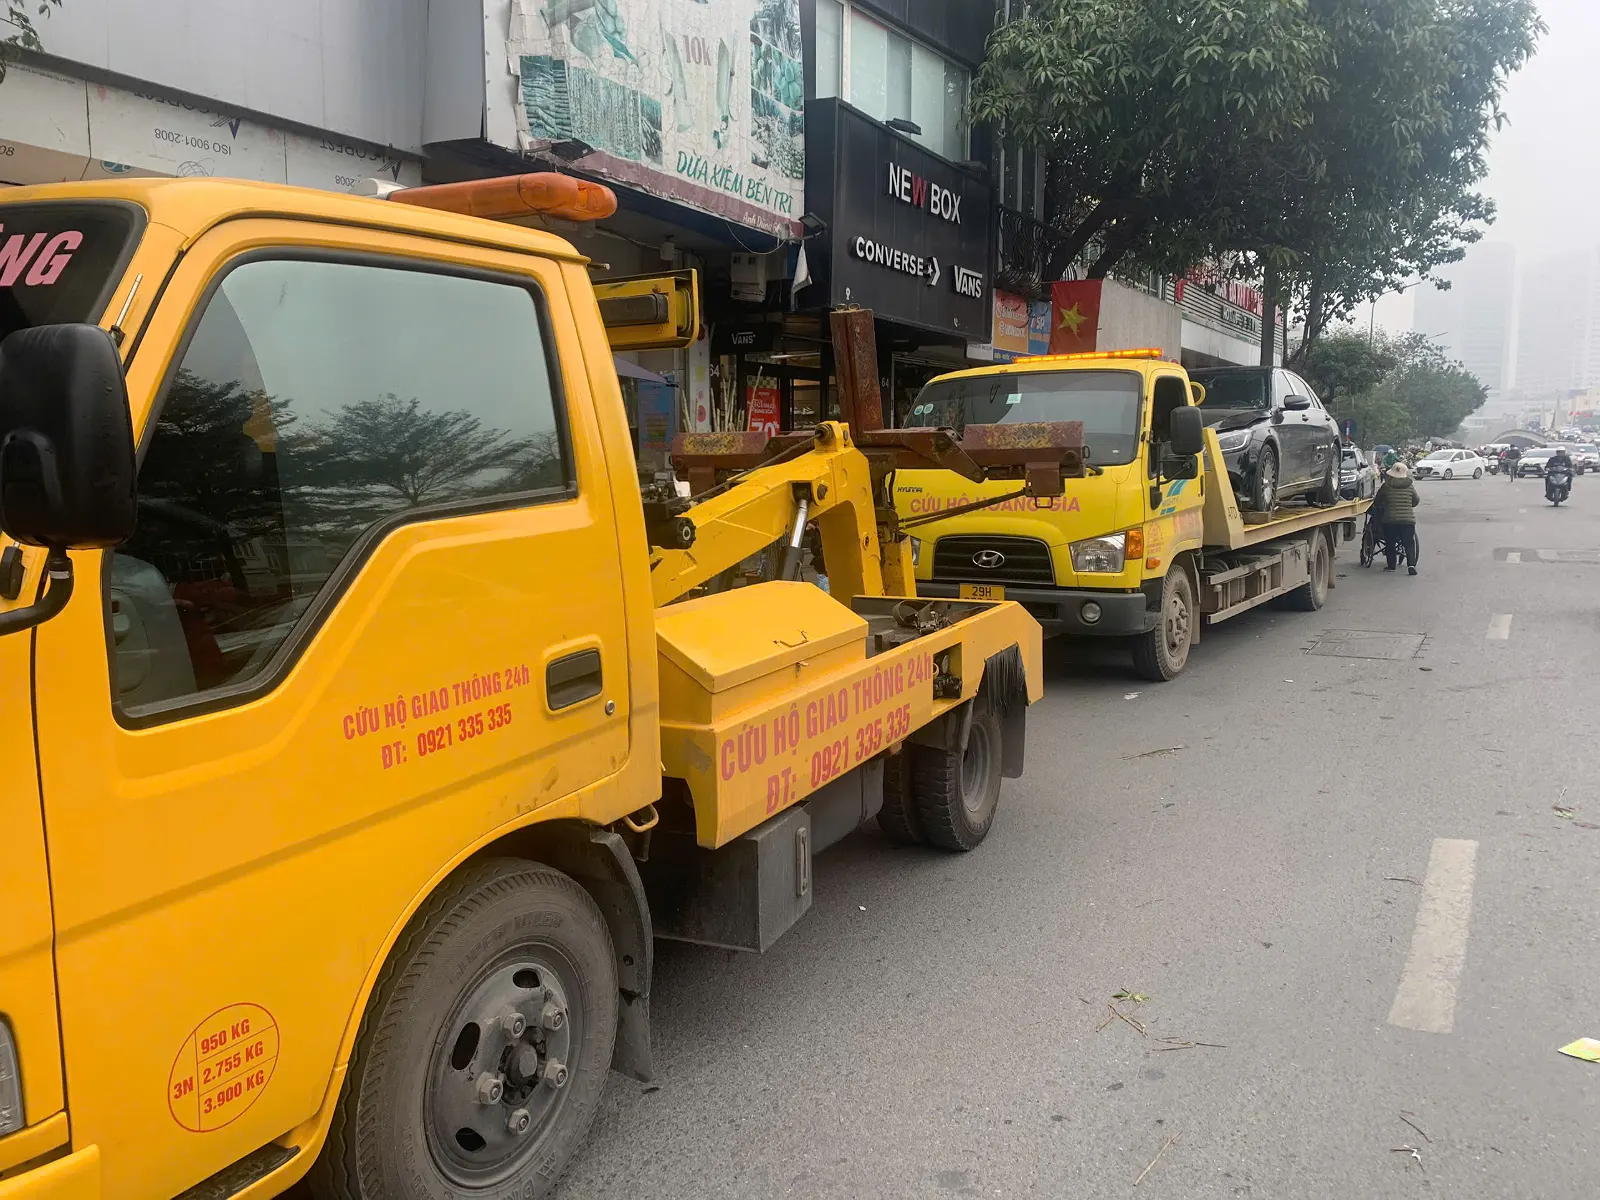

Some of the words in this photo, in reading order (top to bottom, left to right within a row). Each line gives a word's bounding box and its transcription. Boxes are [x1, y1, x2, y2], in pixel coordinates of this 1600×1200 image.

[154, 128, 210, 150] 9001:2008
[213, 142, 231, 155] ISO
[710, 164, 744, 197] XIÊM
[746, 176, 773, 206] BẾN
[889, 161, 927, 209] NEW
[930, 182, 962, 225] BOX
[0, 223, 84, 287] NG
[856, 236, 924, 277] CONVERSE
[954, 264, 983, 299] VANS
[731, 331, 757, 345] VANS
[910, 492, 941, 513] CỨU
[1042, 497, 1081, 514] GIA
[972, 586, 992, 598] 29H
[343, 704, 381, 741] CỨU
[384, 694, 408, 730] HỘ
[411, 686, 450, 720] GIAO
[452, 673, 502, 707] THÔNG
[505, 664, 530, 691] 24h
[721, 720, 767, 782] CỨU
[774, 702, 800, 757] HỘ
[806, 687, 848, 740] GIAO
[853, 664, 904, 715] THÔNG
[907, 651, 932, 689] 24h
[381, 740, 408, 770] ĐT:
[416, 723, 453, 758] 0921
[458, 710, 484, 742] 335
[487, 702, 512, 732] 335
[766, 766, 797, 815] ĐT:
[810, 735, 849, 789] 0921
[855, 717, 882, 762] 335
[886, 702, 911, 744] 335
[201, 1029, 228, 1055] 950
[231, 1018, 250, 1041] KG
[202, 1051, 242, 1085] 2.755
[245, 1040, 264, 1063] KG
[173, 1075, 194, 1100] 3N
[203, 1081, 243, 1114] 3.900
[246, 1069, 265, 1092] KG
